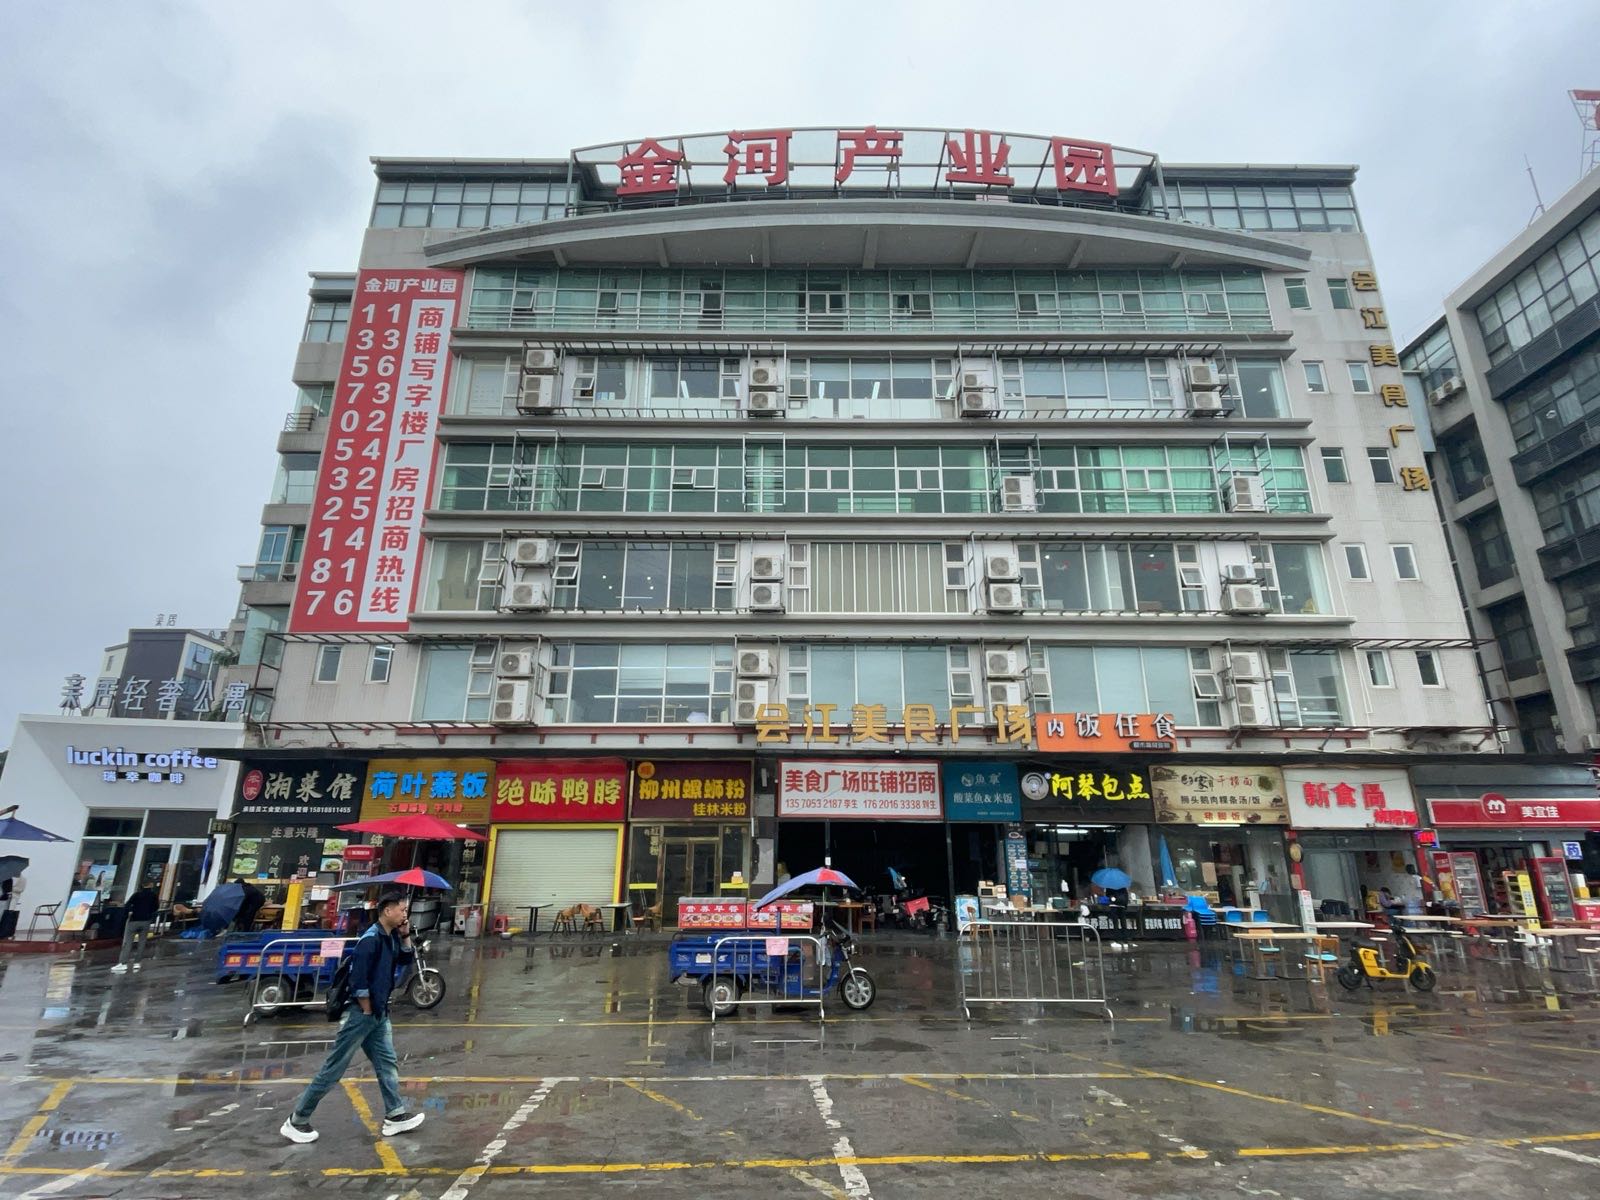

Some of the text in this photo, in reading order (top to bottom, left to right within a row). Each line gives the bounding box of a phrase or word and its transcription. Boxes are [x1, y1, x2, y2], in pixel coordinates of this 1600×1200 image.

[616, 125, 1119, 196] 金河产业园
[364, 278, 457, 293] 金河产业园
[1352, 270, 1430, 491] 会江美食广场
[369, 306, 445, 614] 商铺写字楼厂房招商热线
[755, 703, 1032, 744] 会江美食广场
[66, 746, 218, 769] luckin coffee
[103, 770, 186, 784] 瑞幸咖啡
[264, 770, 358, 802] 湘菜馆
[370, 770, 489, 799] 荷叶蒸饭
[639, 779, 745, 800] 柳州螺蛳粉
[785, 769, 936, 794] 美食广场旺铺招商
[496, 777, 621, 806] 绝味鸭脖
[693, 803, 747, 816] 桂林米粉
[1521, 806, 1560, 818] 美宜佳
[271, 827, 318, 838] 生意兴隆
